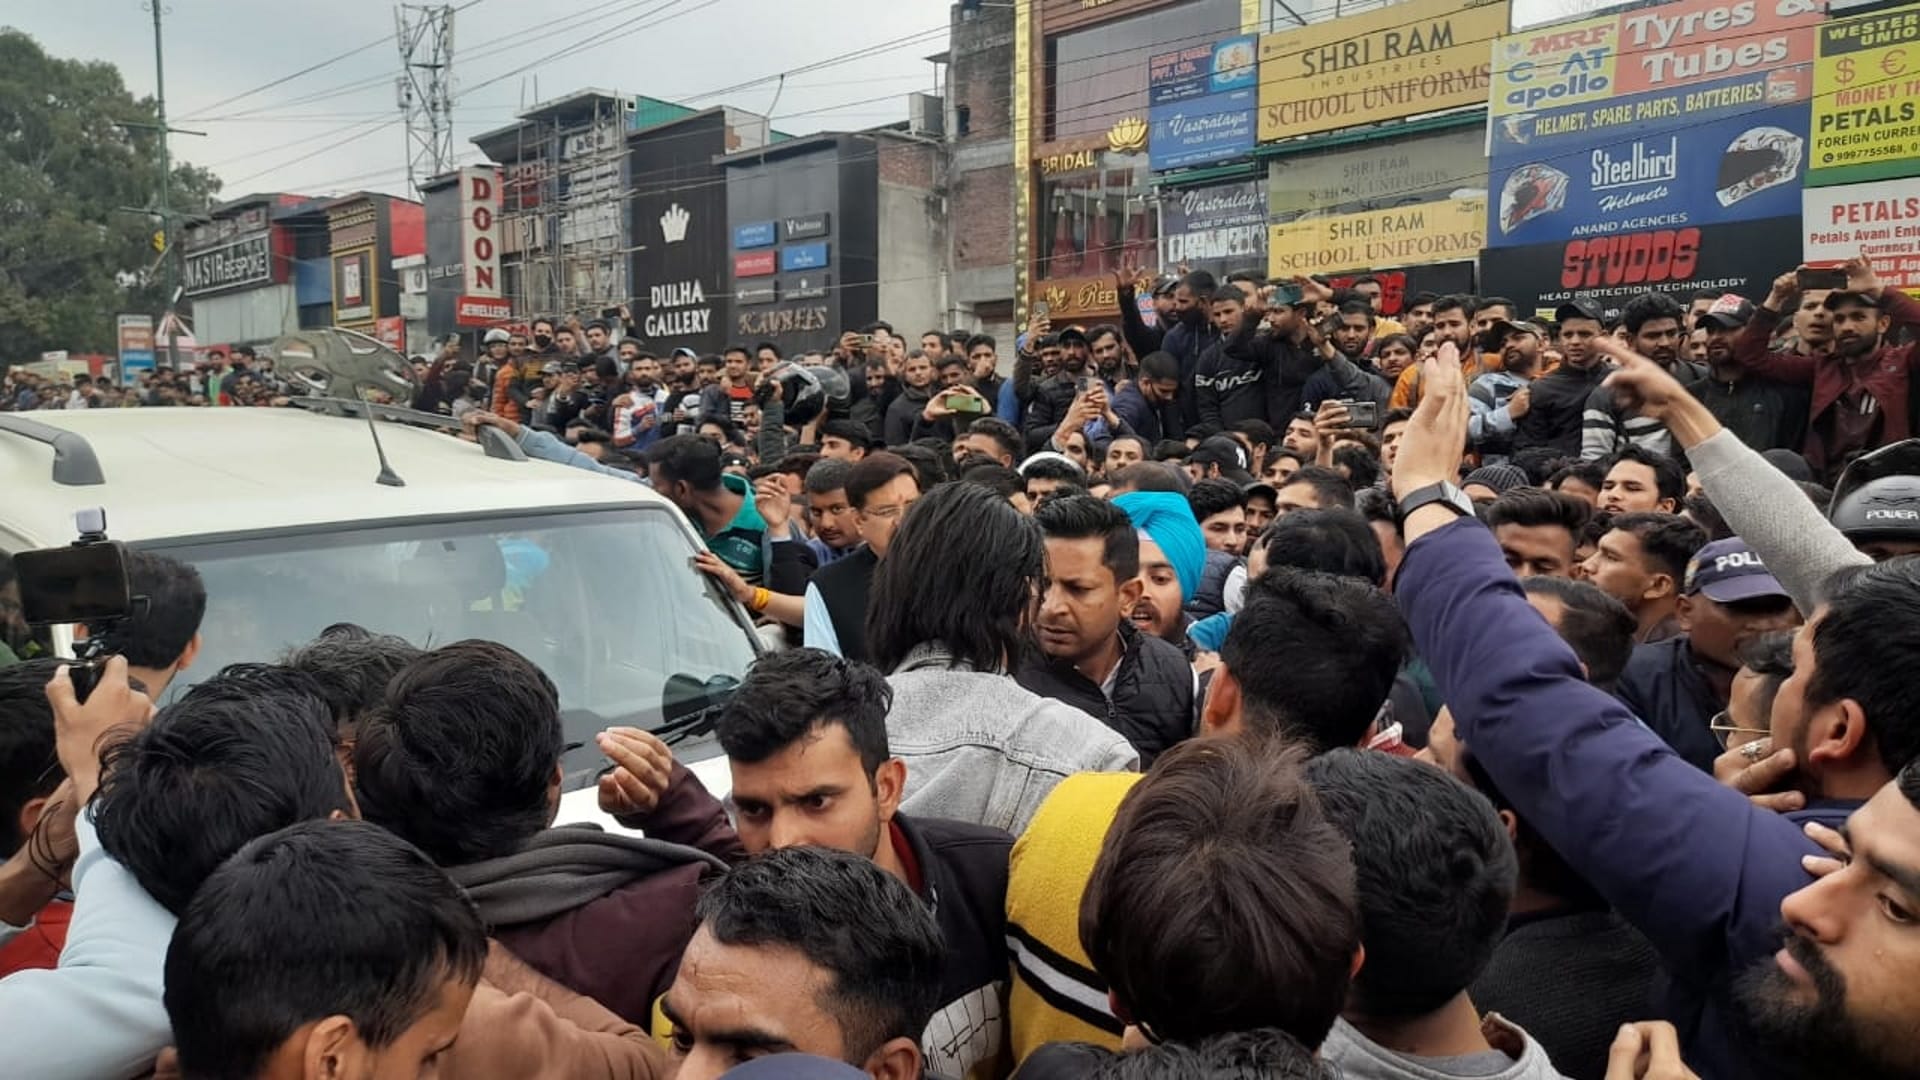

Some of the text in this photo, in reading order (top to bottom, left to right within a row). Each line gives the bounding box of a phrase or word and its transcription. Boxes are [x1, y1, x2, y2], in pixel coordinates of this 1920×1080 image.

[1527, 23, 1616, 56] MRF
[1625, 2, 1755, 49] Tyres
[1828, 14, 1918, 40] WESTER
[1860, 26, 1917, 46] UNIO
[1301, 20, 1454, 78] SHRI RAM
[1642, 37, 1788, 84] Tubes
[1311, 55, 1442, 90] INDUSTRIES
[1267, 63, 1491, 129] SCHOOL UNIFORMS
[1507, 74, 1608, 108] apollo
[1836, 84, 1897, 107] MONEY
[1535, 113, 1588, 136] HELMET,
[1591, 106, 1633, 128] SPARE
[1636, 100, 1681, 122] PARTS,
[1685, 81, 1763, 113] BATTERIES
[1820, 102, 1915, 133] PETALS
[1818, 132, 1870, 149] FOREIGN
[1042, 149, 1094, 174] BRIDAL
[1591, 136, 1678, 188] Steelbird
[1599, 184, 1669, 212] Helmets
[1832, 197, 1920, 225] PETALS
[472, 177, 494, 290] DOON
[1329, 218, 1373, 240] SHRI
[1382, 212, 1425, 234] RAM
[1571, 212, 1688, 236] ANAND AGENCIES
[1810, 231, 1850, 245] Petals
[1855, 228, 1890, 241] Avani
[1280, 230, 1483, 270] SCHOOL UNIFORMS
[1561, 227, 1702, 289] STUDDS
[1859, 243, 1914, 255] Currency
[186, 252, 265, 288] NASIR BESPOKE
[651, 279, 705, 309] DULHA
[1539, 278, 1748, 301] HEAD PROTECTION TECHNOLOGY
[645, 309, 711, 336] GALLERY
